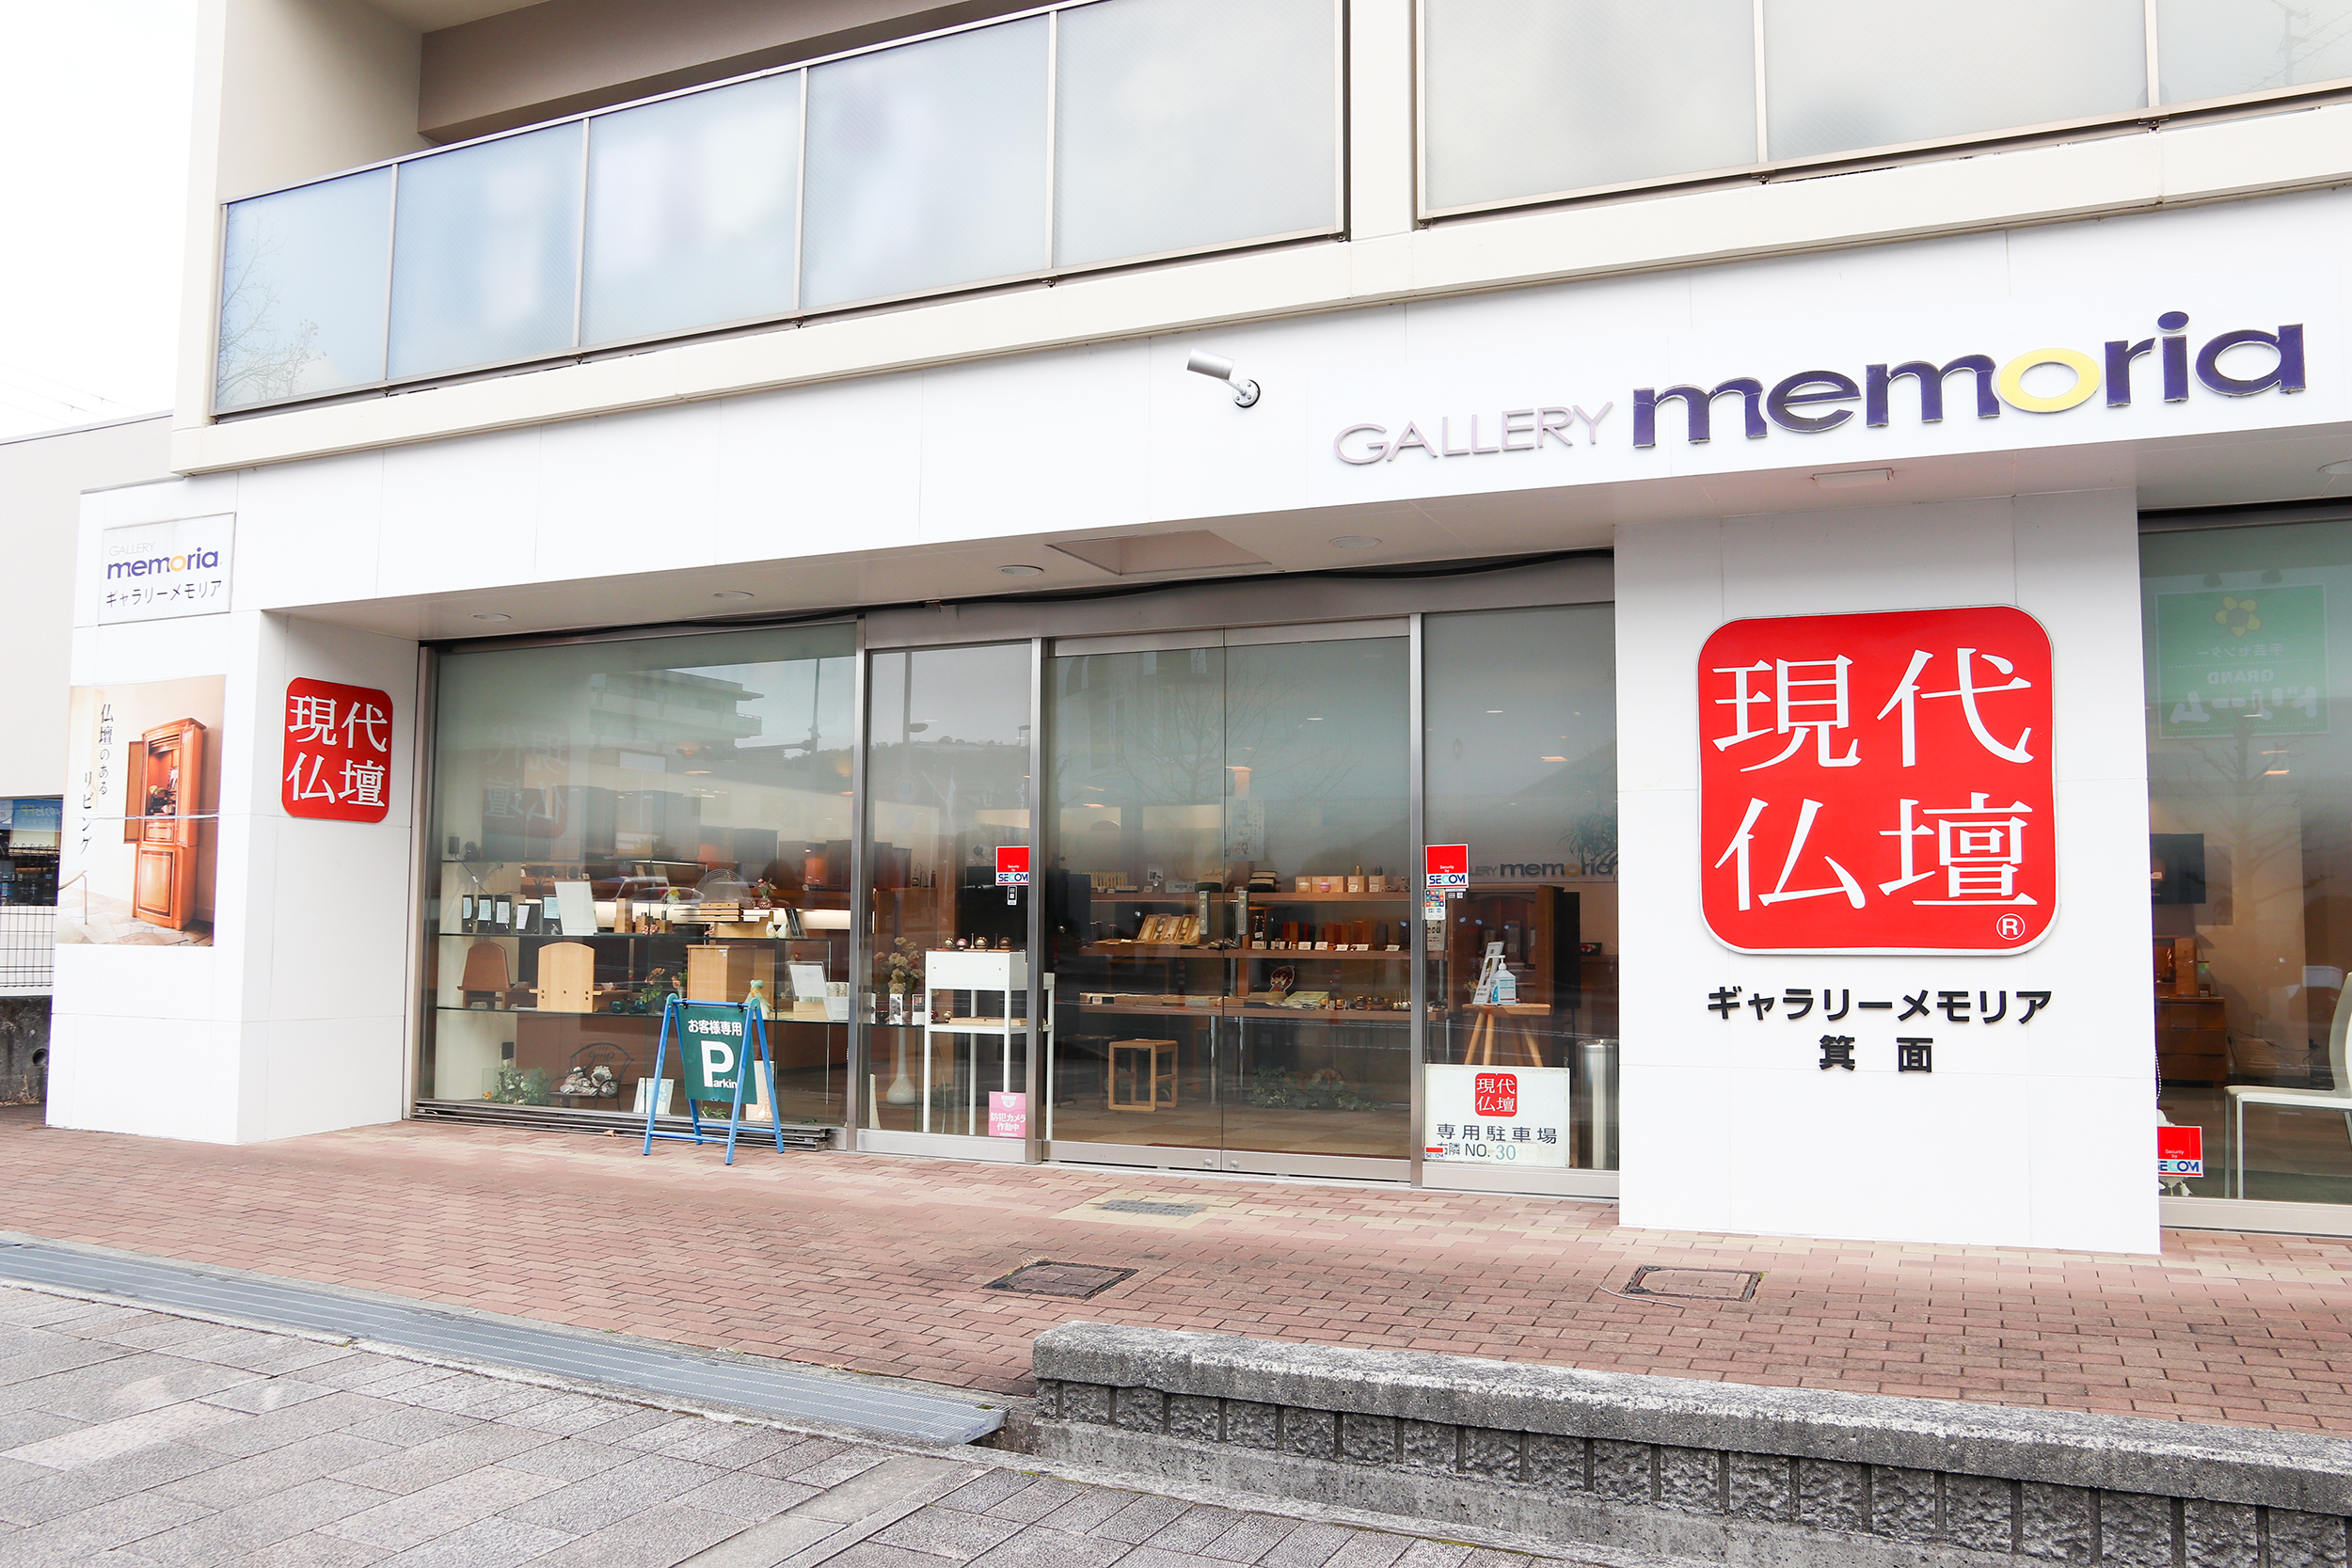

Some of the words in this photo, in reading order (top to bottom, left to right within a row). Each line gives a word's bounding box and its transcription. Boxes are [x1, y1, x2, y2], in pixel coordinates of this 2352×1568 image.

[1333, 402, 1613, 465] GALLERY
[1632, 311, 2306, 448] memoria
[109, 542, 155, 556] GALLERY
[107, 547, 218, 579] memoria
[106, 580, 222, 608] ギャラリーメモリア
[1711, 647, 2035, 772] 現代
[288, 695, 388, 752] 現代
[99, 704, 114, 795] 仏壇のある
[285, 752, 386, 807] 仏壇
[79, 770, 94, 856] リビング
[1714, 792, 2038, 911] 仏壇
[998, 873, 1028, 882] SECOM
[1429, 874, 1466, 885] SECOM
[1470, 865, 1498, 877] LERY
[1708, 986, 2052, 1024] ギャラリーメモリア
[688, 1019, 743, 1037] お客様専用
[700, 1039, 739, 1089] Parkin
[1476, 1078, 1516, 1095] 現代
[1476, 1096, 1516, 1113] 仏壇
[990, 1112, 1026, 1123] 防犯カメラ
[997, 1121, 1020, 1132] 作動中
[1437, 1123, 1558, 1145] 専用駐車場
[1465, 1143, 1490, 1158] NO.
[1496, 1145, 1517, 1161] 30
[2158, 1160, 2200, 1172] ECOM
